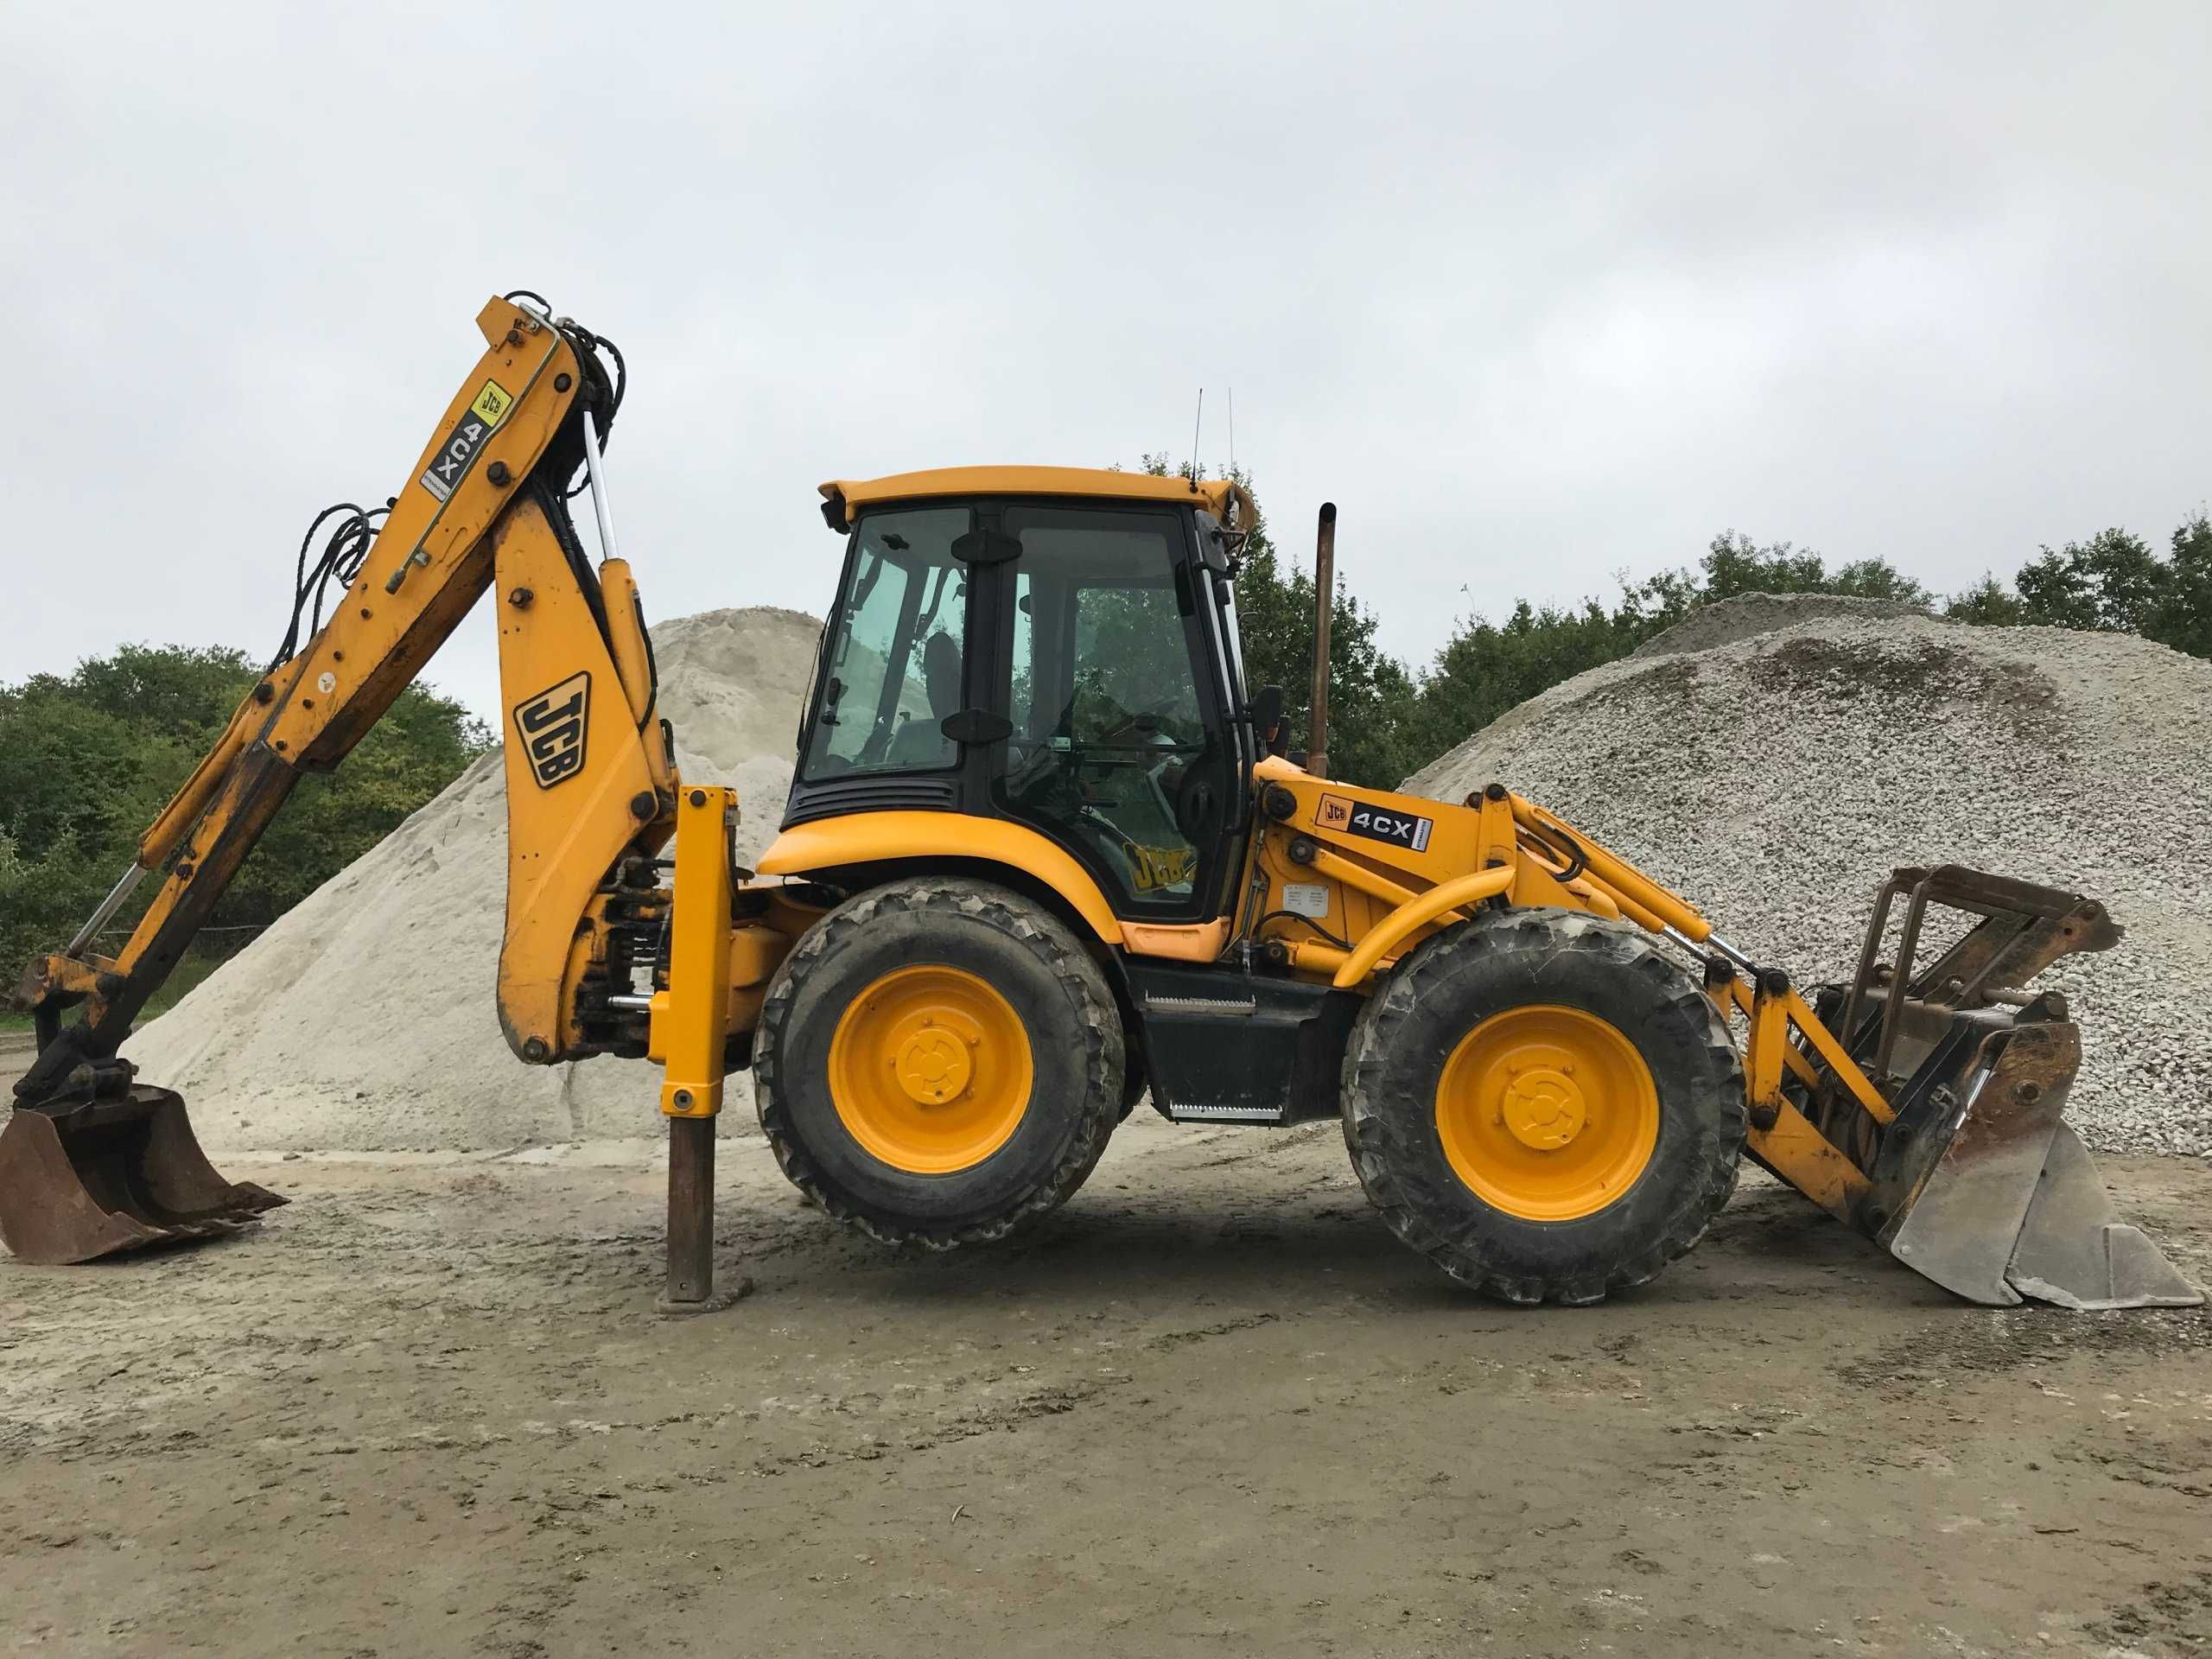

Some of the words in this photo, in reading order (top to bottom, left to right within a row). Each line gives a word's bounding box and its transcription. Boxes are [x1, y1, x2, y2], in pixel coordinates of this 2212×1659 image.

[482, 392, 501, 415] JCB
[436, 423, 482, 481] 4CX
[522, 690, 583, 781] JCB
[1327, 804, 1346, 821] JCB
[1353, 812, 1412, 840] 4CX
